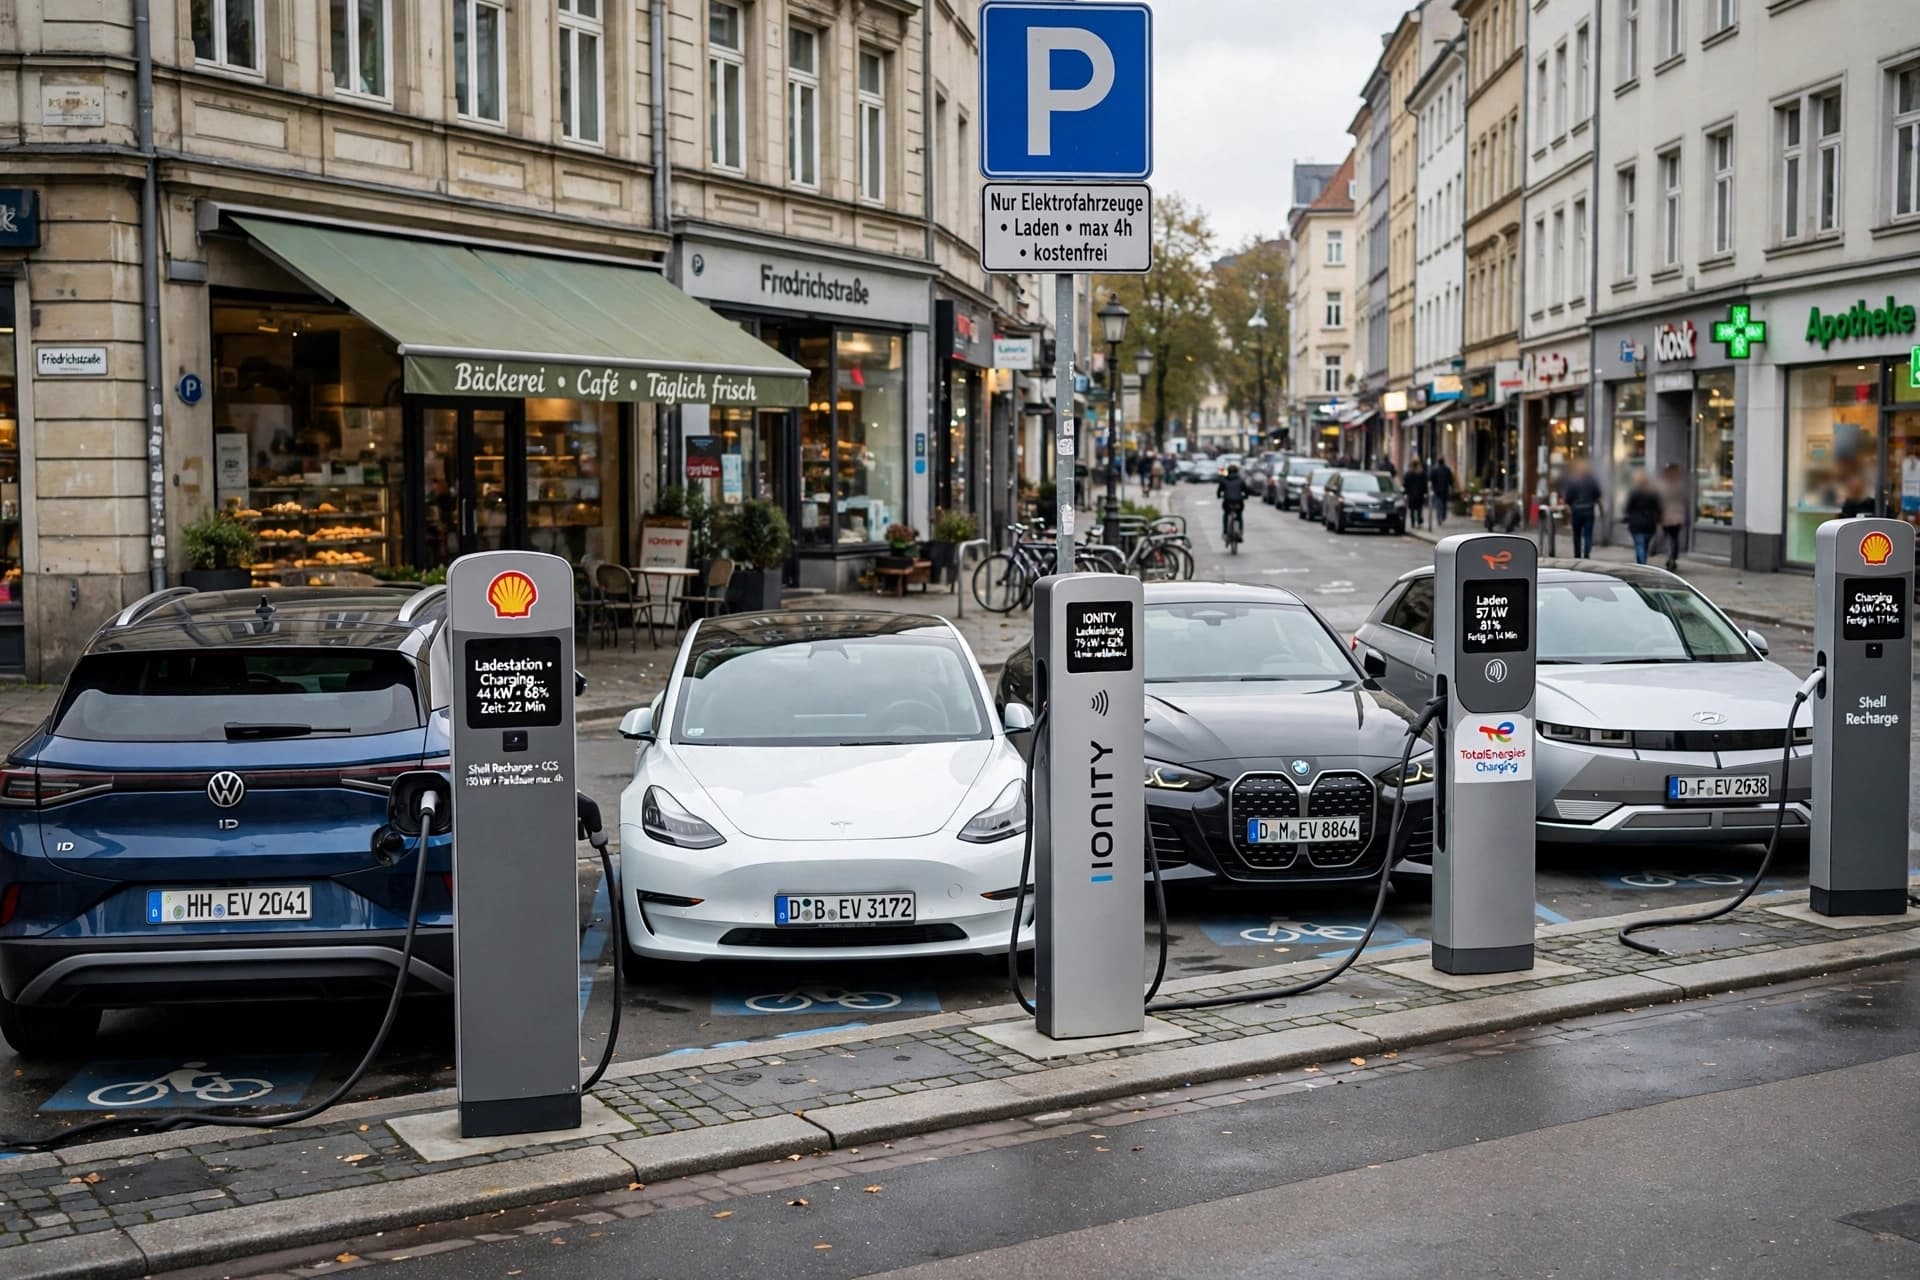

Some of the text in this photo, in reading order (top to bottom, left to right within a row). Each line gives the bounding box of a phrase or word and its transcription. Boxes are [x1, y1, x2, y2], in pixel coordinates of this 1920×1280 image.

[1027, 27, 1115, 155] P
[991, 193, 1143, 216] Nur Elektrofahrzeuge
[1015, 218, 1132, 237] Laden max 4h
[1034, 243, 1108, 262] kostenfrei
[1805, 295, 1916, 351] Apotheke
[1653, 320, 1697, 361] Kiosk
[186, 379, 197, 397] P
[454, 362, 757, 404] Bäckerei Café Täglich frisch
[1476, 594, 1508, 606] Laden
[1082, 612, 1117, 624] IONITY
[1476, 606, 1509, 619] 57 kW
[475, 658, 543, 672] Ladestation
[476, 686, 550, 700] 44 kW 68%
[480, 701, 546, 714] Zeit: 22 Min
[1859, 695, 1887, 709] Shell
[1846, 711, 1899, 727] Recharge
[541, 761, 559, 771] CCS
[1476, 760, 1518, 774] Charging
[1679, 779, 1688, 795] D
[1697, 779, 1705, 795] F
[1715, 779, 1732, 795] EV
[1260, 820, 1357, 839] D M EV 8864
[56, 842, 74, 851] ID
[187, 891, 307, 918] HH EV 2041
[790, 898, 912, 920] D B EV 3172
